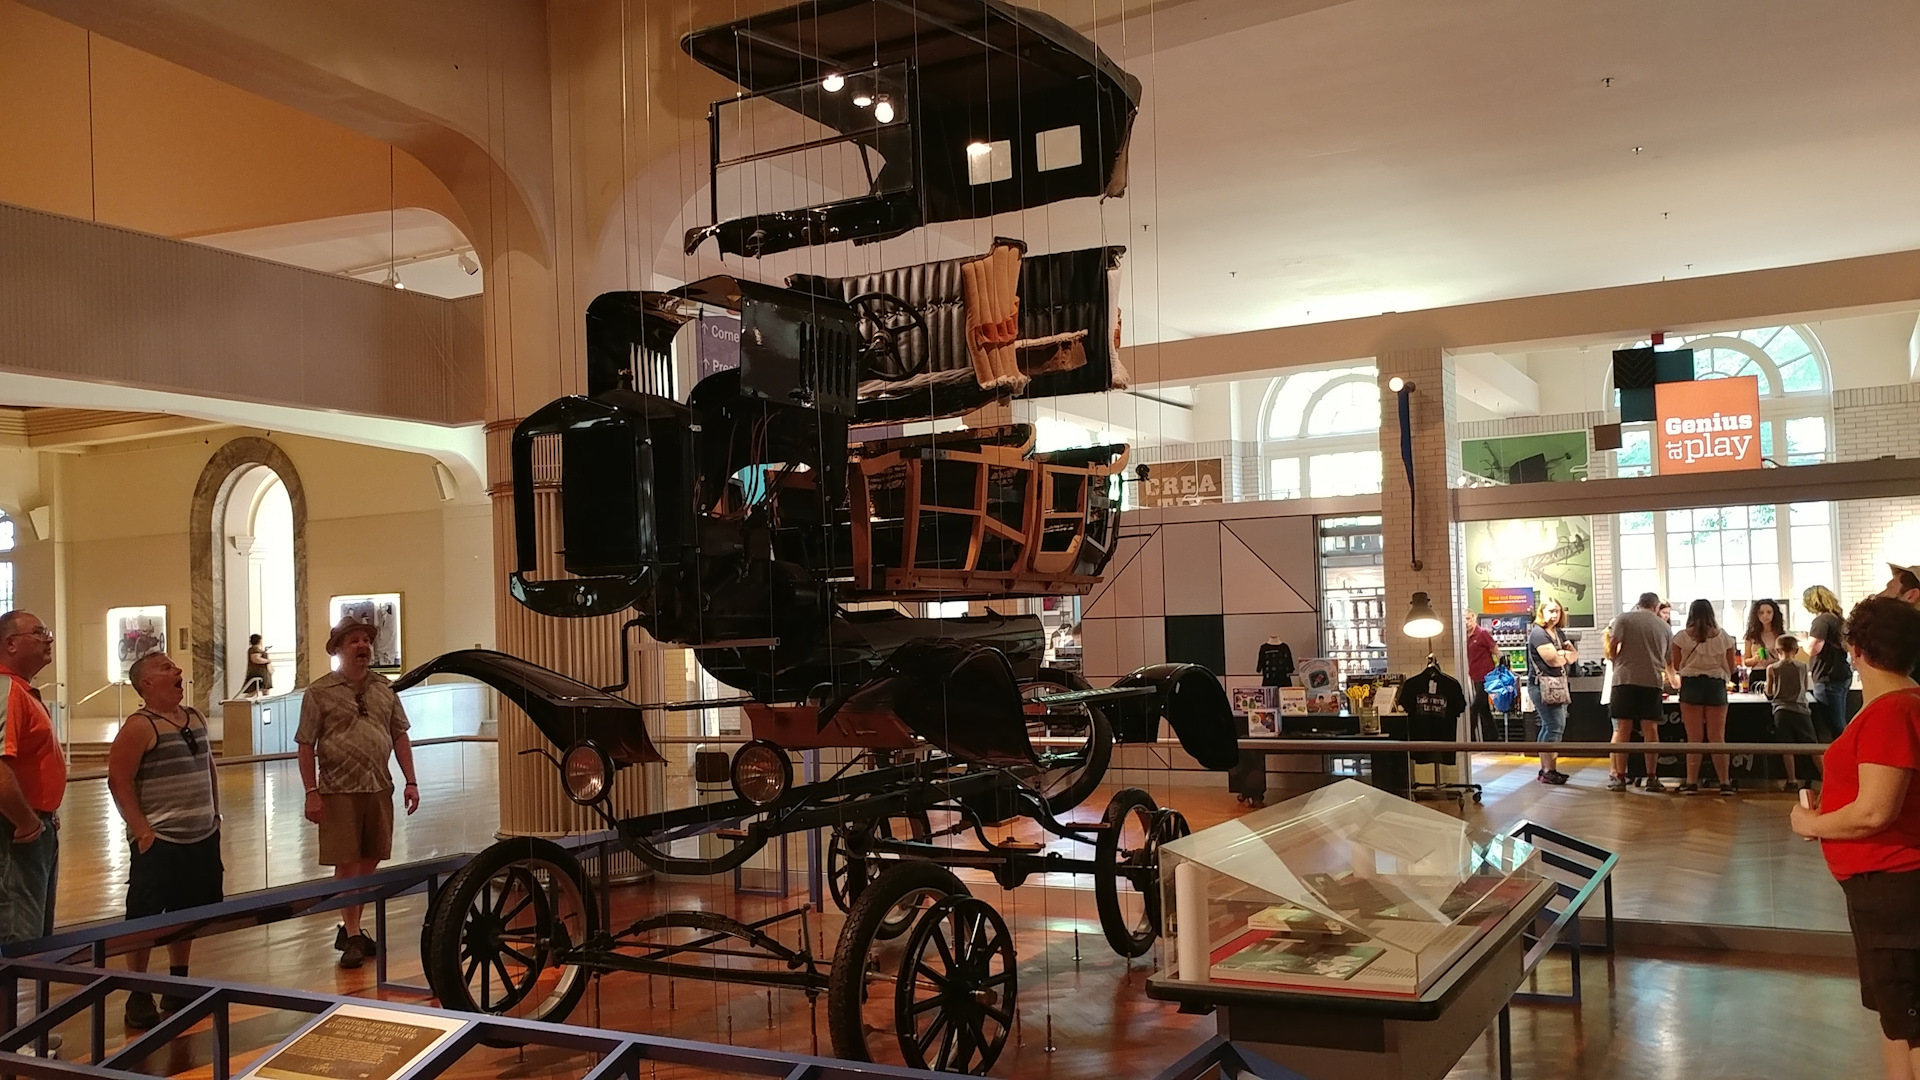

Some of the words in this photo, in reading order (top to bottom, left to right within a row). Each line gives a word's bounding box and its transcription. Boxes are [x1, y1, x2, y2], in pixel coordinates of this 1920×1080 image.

[711, 325, 740, 343] Corne
[712, 359, 738, 372] Pre
[1665, 412, 1753, 436] Genius
[1665, 440, 1683, 460] at
[1684, 432, 1753, 464] play
[1145, 474, 1217, 496] CREA
[1501, 620, 1520, 628] pepsi
